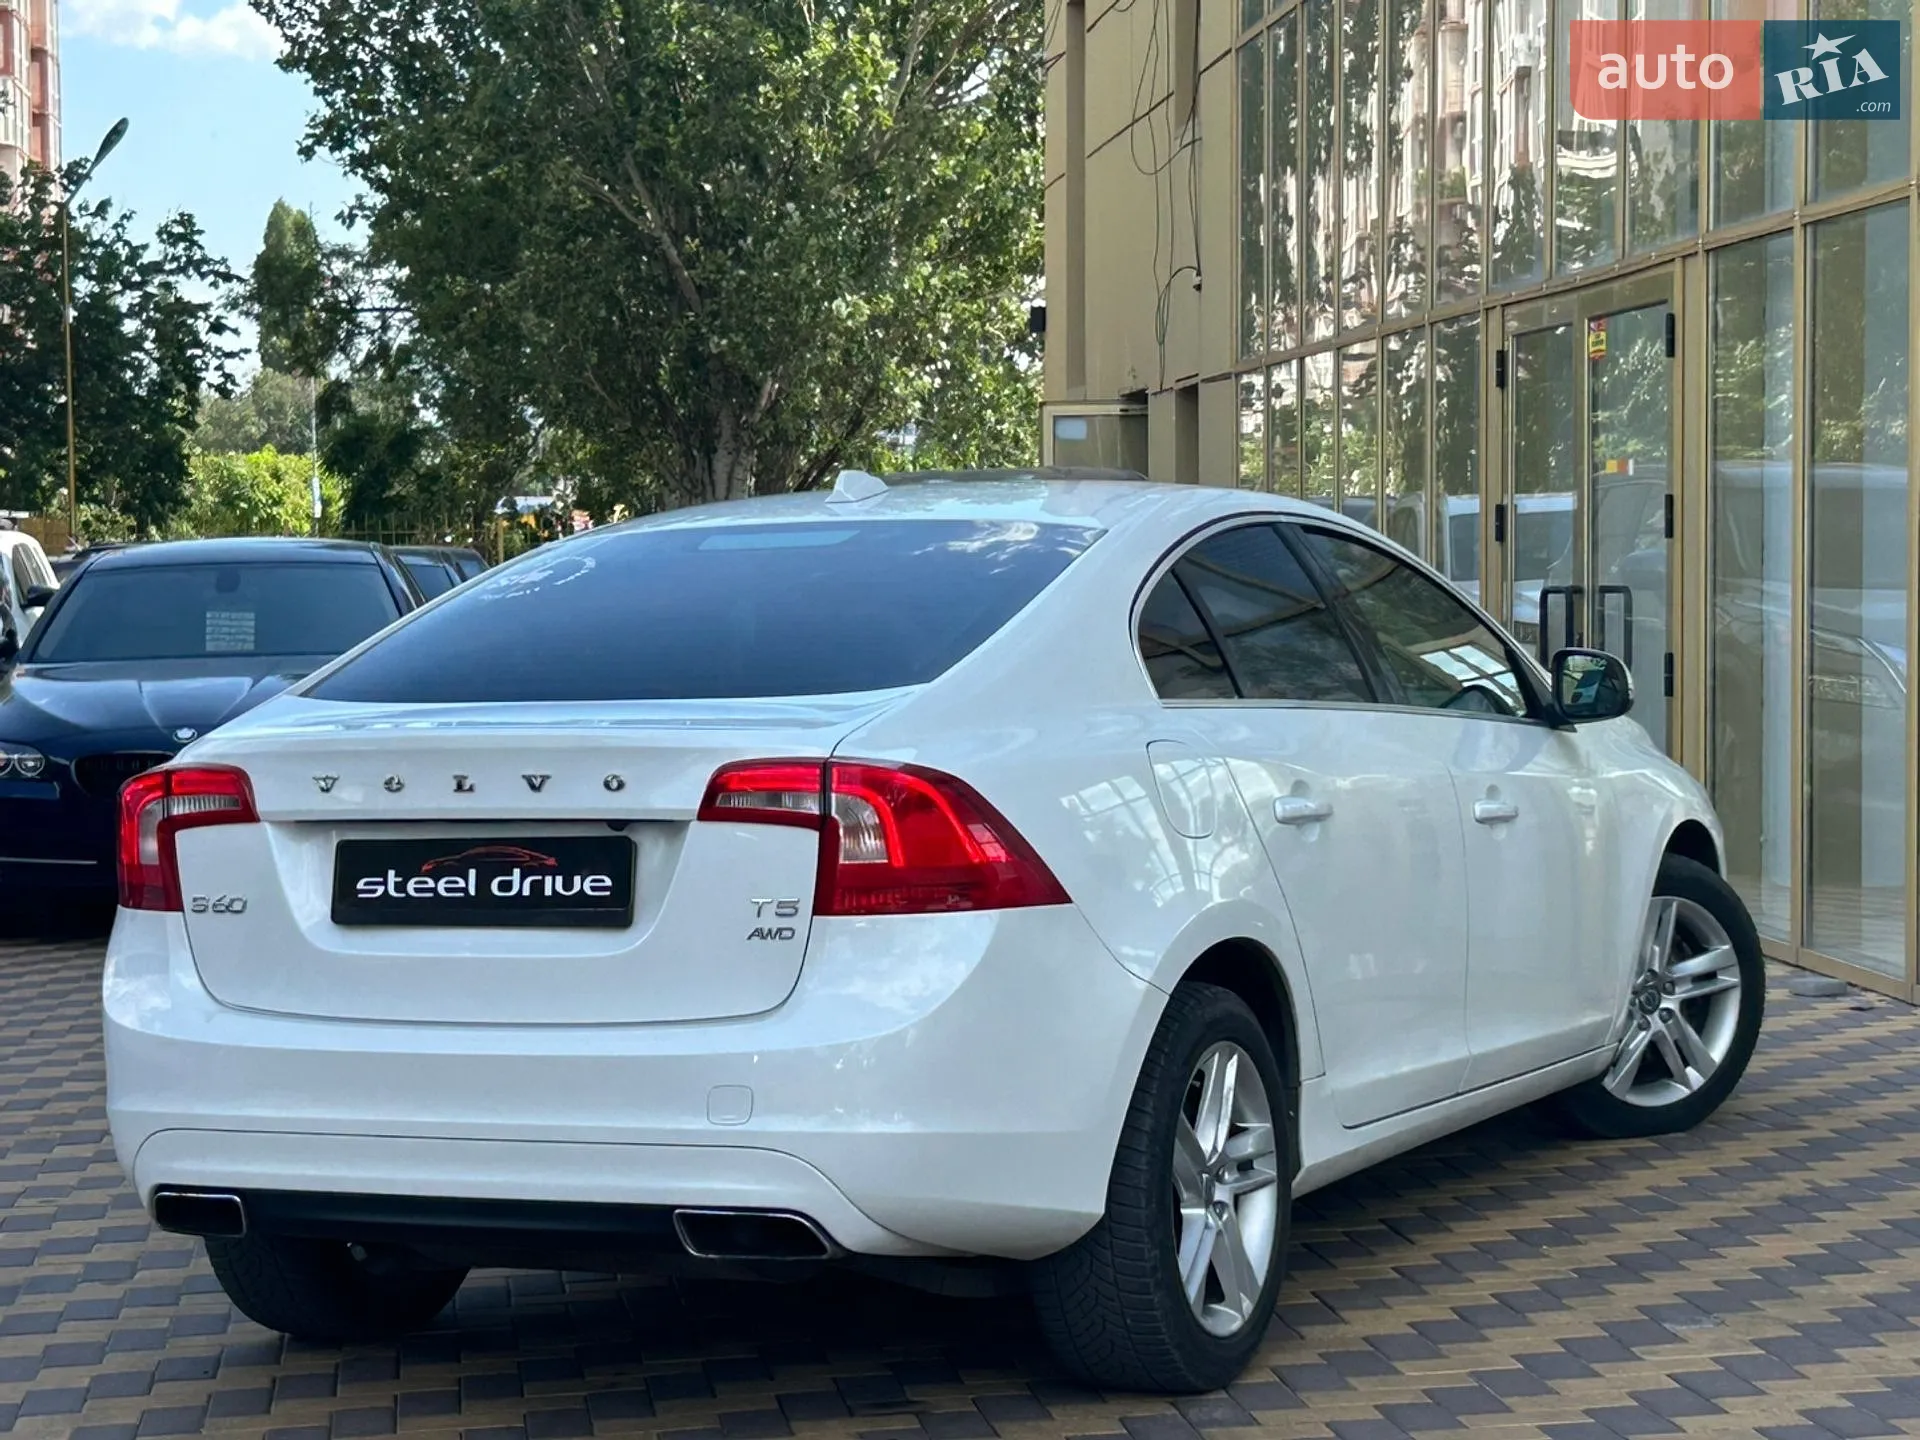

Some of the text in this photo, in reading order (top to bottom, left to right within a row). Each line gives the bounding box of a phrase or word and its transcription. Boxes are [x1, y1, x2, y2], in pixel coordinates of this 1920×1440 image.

[312, 773, 626, 793] VOLVO
[356, 867, 612, 898] steel drive
[191, 895, 248, 914] S60
[751, 898, 800, 918] T5
[746, 926, 796, 941] AWD
